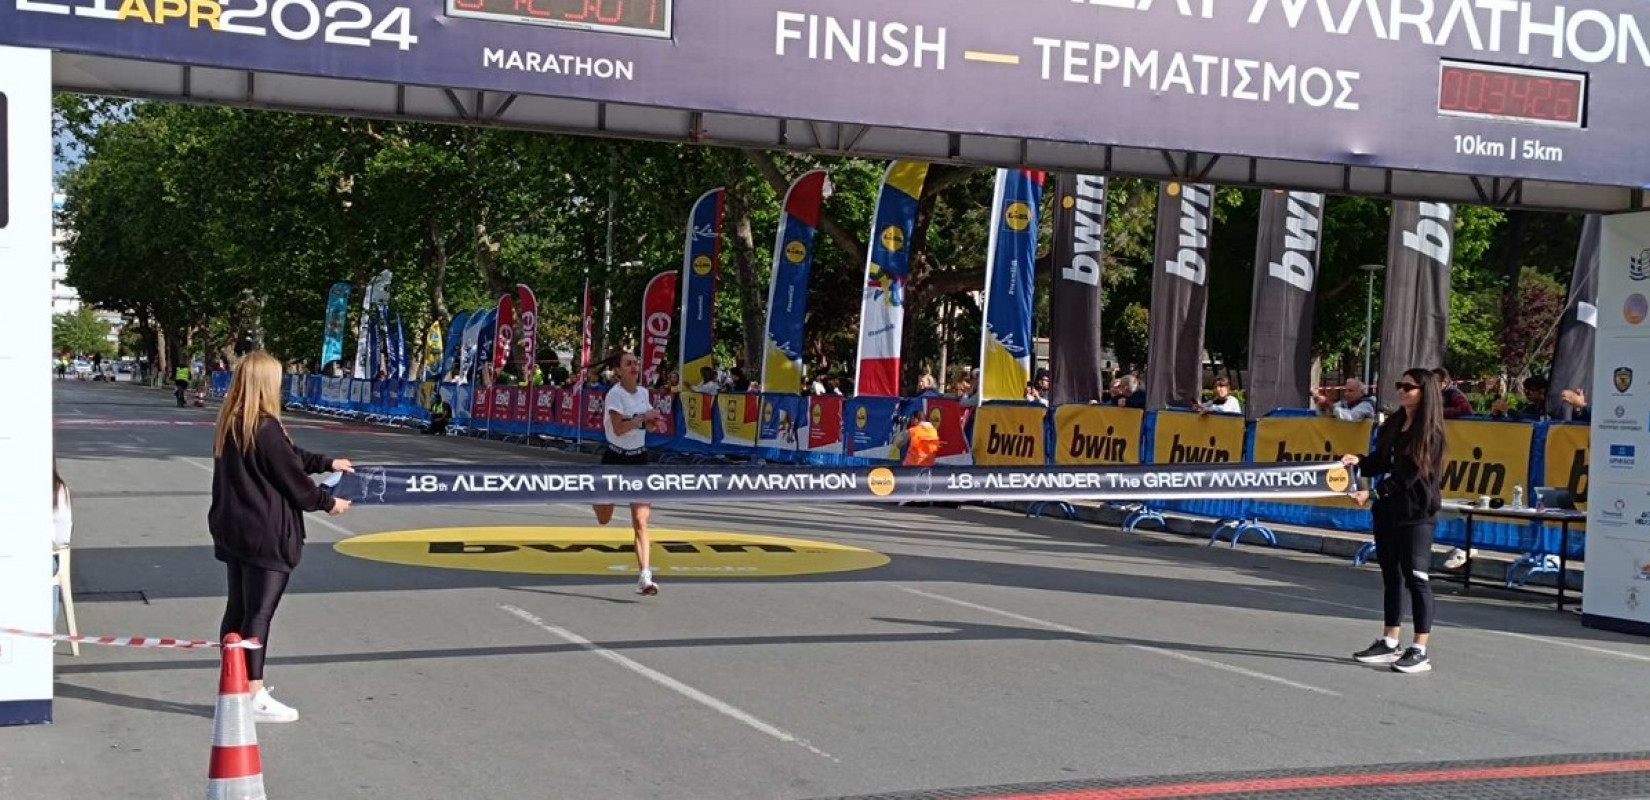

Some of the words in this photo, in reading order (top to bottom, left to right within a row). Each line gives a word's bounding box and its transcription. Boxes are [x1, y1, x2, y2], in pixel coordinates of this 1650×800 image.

[219, 0, 418, 51] 2024
[482, 47, 634, 80] MARATHON
[775, 10, 947, 70] FINISH
[1032, 36, 1360, 110] ΤΕΡΜΑΤΙΣΜΟΣ
[1454, 135, 1504, 157] 10km
[1522, 140, 1563, 161] 5km
[1062, 174, 1104, 286] bwin
[987, 424, 1035, 458] bwin
[1070, 424, 1128, 462] bwin
[452, 474, 596, 491] ALEXANDER
[602, 474, 643, 491] The
[646, 473, 723, 491] GREAT
[727, 472, 857, 490] MARATHON
[984, 473, 1101, 489] ALEXANDER
[1106, 473, 1140, 488] The
[1143, 472, 1206, 488] GREAT
[1209, 471, 1317, 487] MARATHON
[1440, 446, 1506, 496] win
